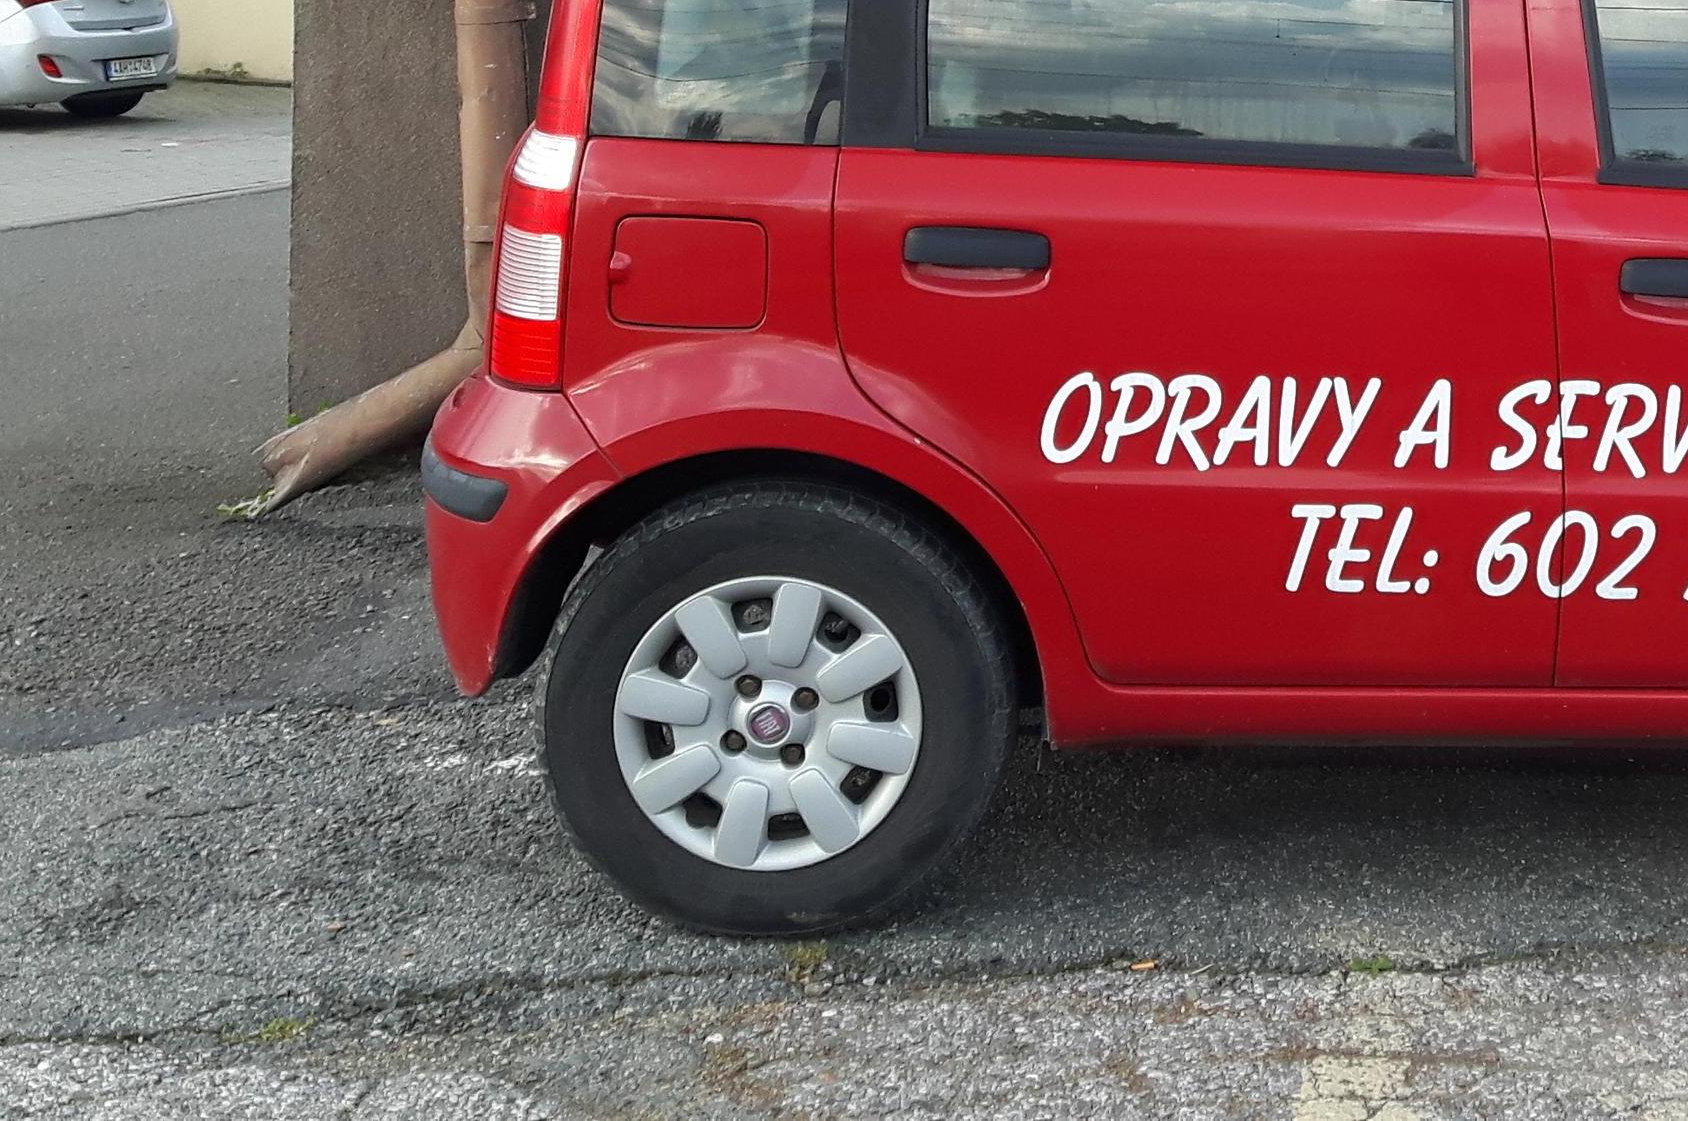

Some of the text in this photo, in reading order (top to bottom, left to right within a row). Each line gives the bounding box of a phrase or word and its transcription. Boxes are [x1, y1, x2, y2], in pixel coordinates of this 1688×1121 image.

[1040, 371, 1382, 472] OPRAVY
[1393, 378, 1452, 469] A
[1285, 503, 1439, 595] TEL:
[1476, 509, 1657, 600] 602
[755, 711, 781, 736] FIAT
